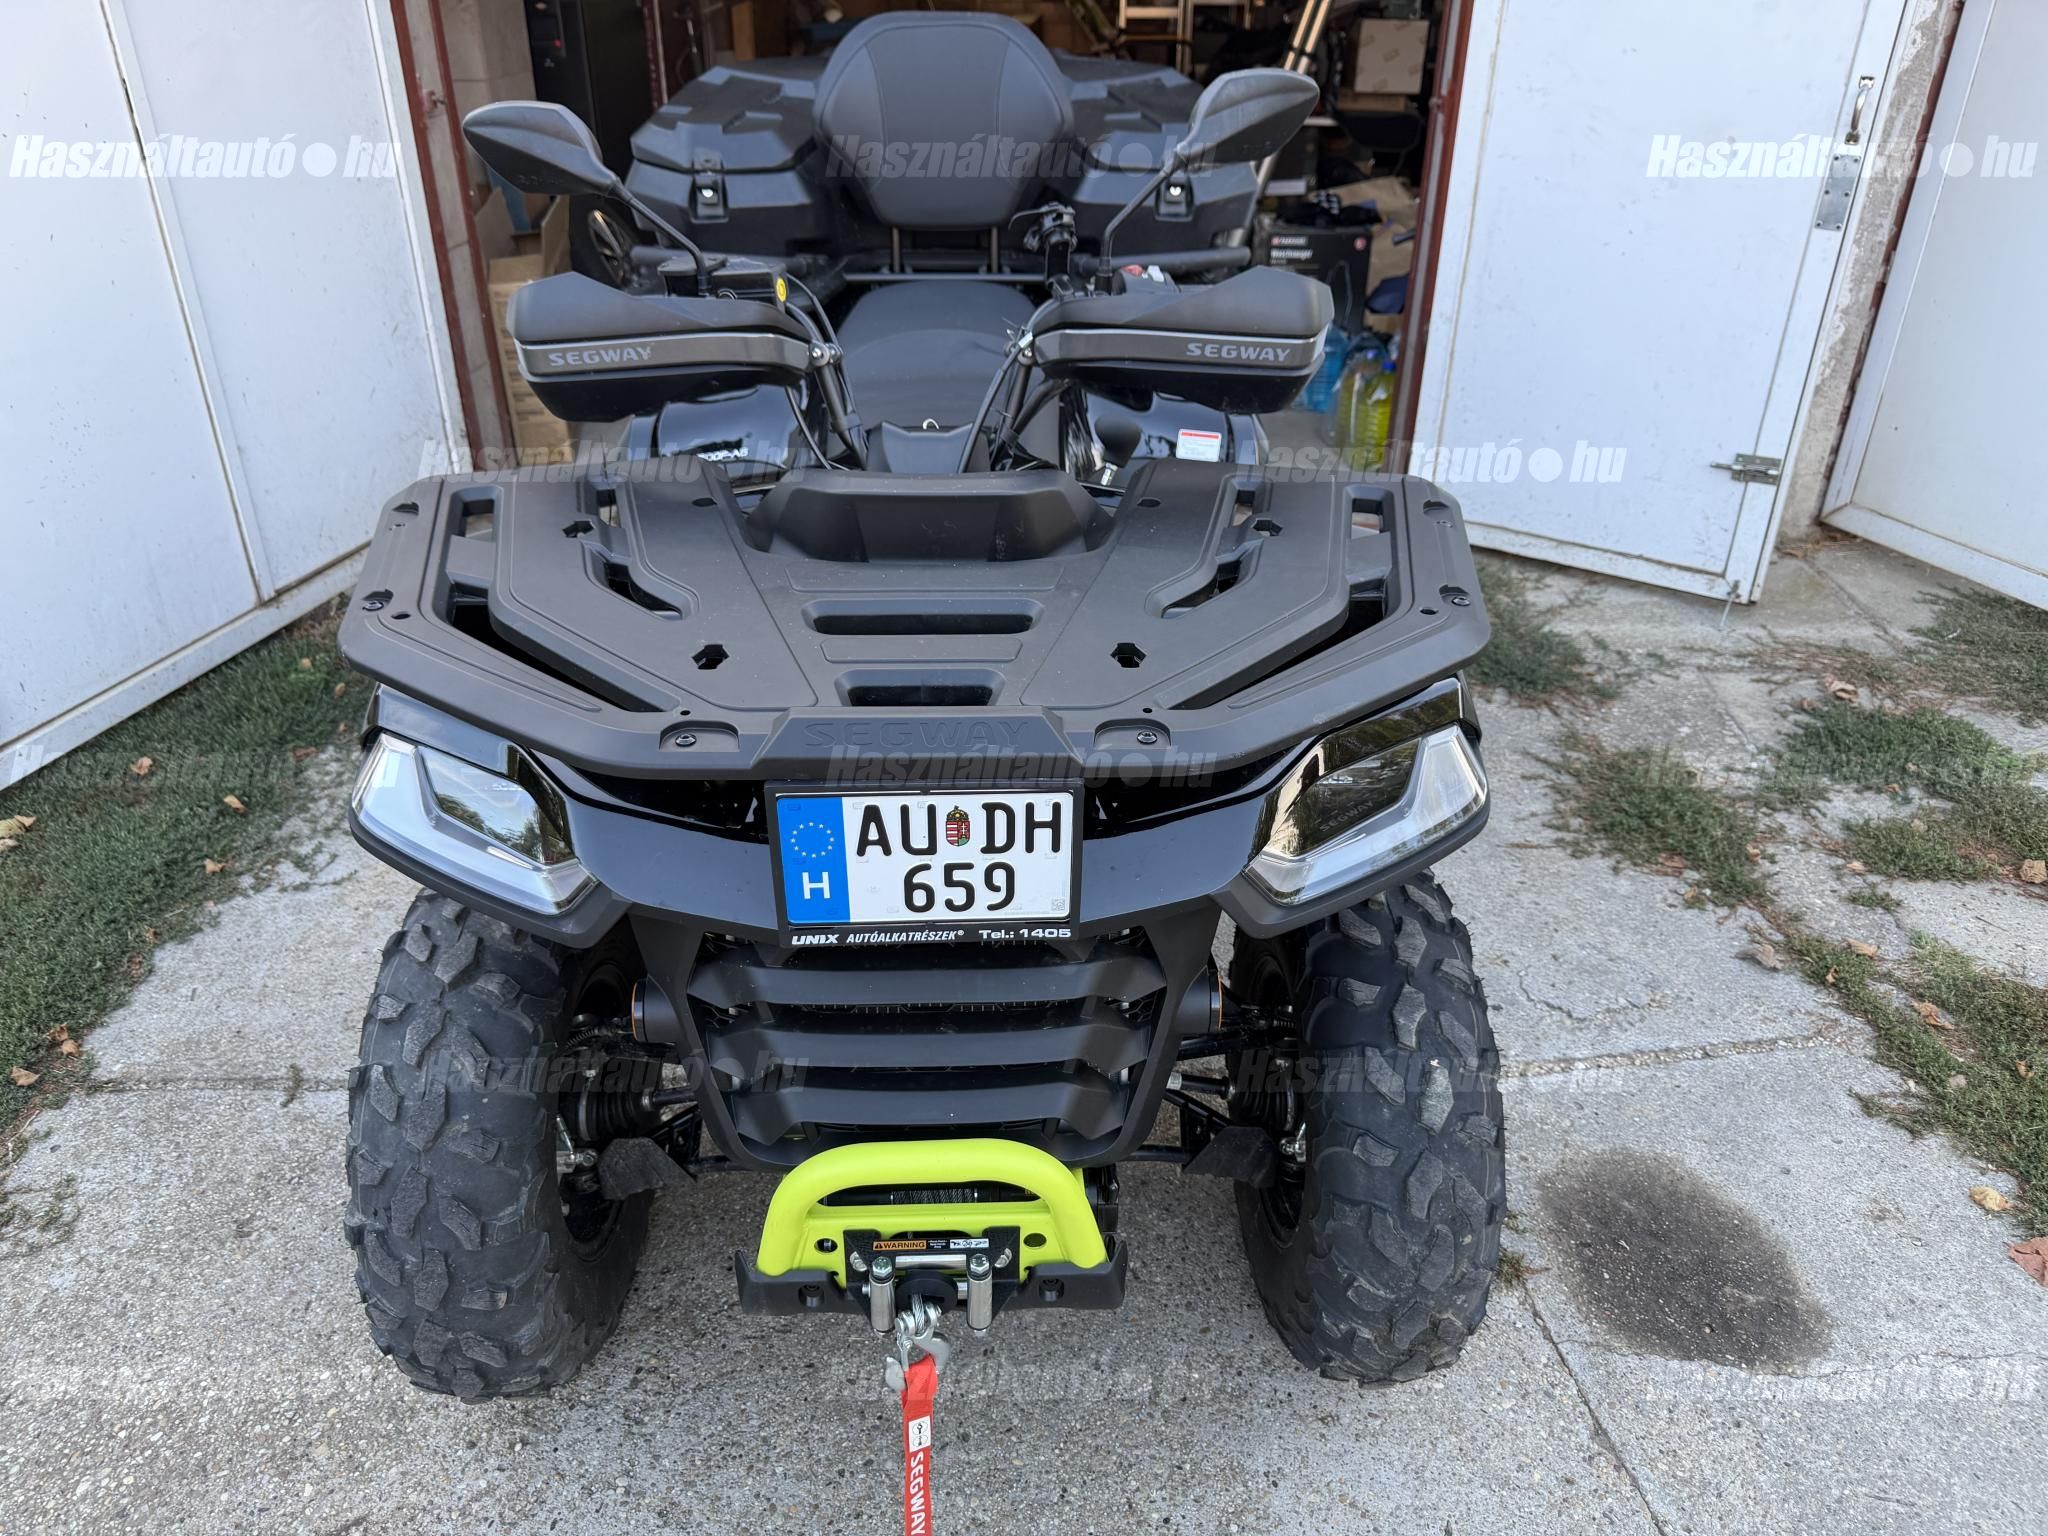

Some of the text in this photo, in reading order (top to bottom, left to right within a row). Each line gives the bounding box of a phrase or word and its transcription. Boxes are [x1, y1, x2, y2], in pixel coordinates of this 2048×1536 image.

[547, 345, 652, 367] SEGWAY
[1185, 342, 1291, 361] SEGWAY
[803, 721, 1030, 748] SEGWAY
[856, 800, 1062, 857] AU DH
[801, 871, 831, 900] H
[903, 861, 1015, 913] 659
[791, 933, 840, 945] UNIX
[978, 928, 1015, 940] Tel.:
[1019, 928, 1072, 939] 1405
[883, 1241, 926, 1250] WARNING
[910, 1451, 926, 1536] SEGWAY
